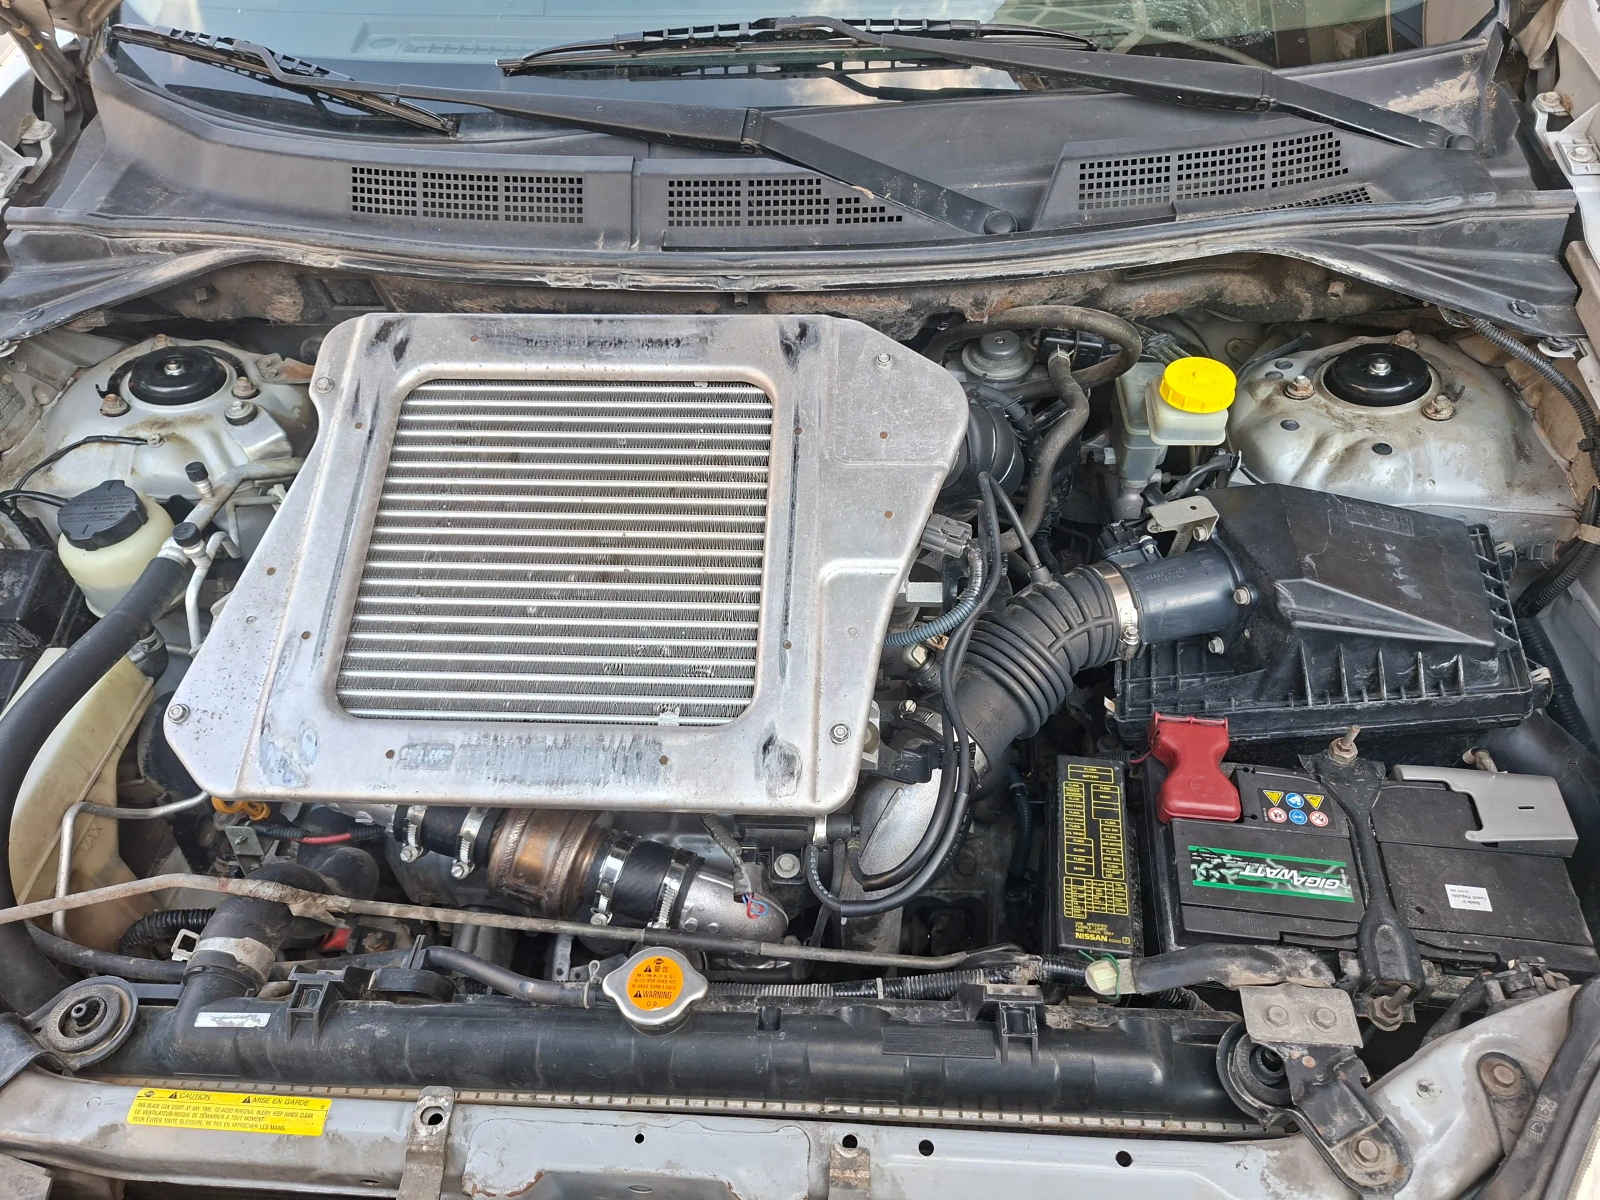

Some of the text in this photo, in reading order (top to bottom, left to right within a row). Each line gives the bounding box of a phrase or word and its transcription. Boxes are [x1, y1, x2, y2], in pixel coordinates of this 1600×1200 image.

[1240, 864, 1341, 890] GIGAWATT
[1075, 932, 1108, 942] NISSAN
[642, 990, 672, 999] WARNING
